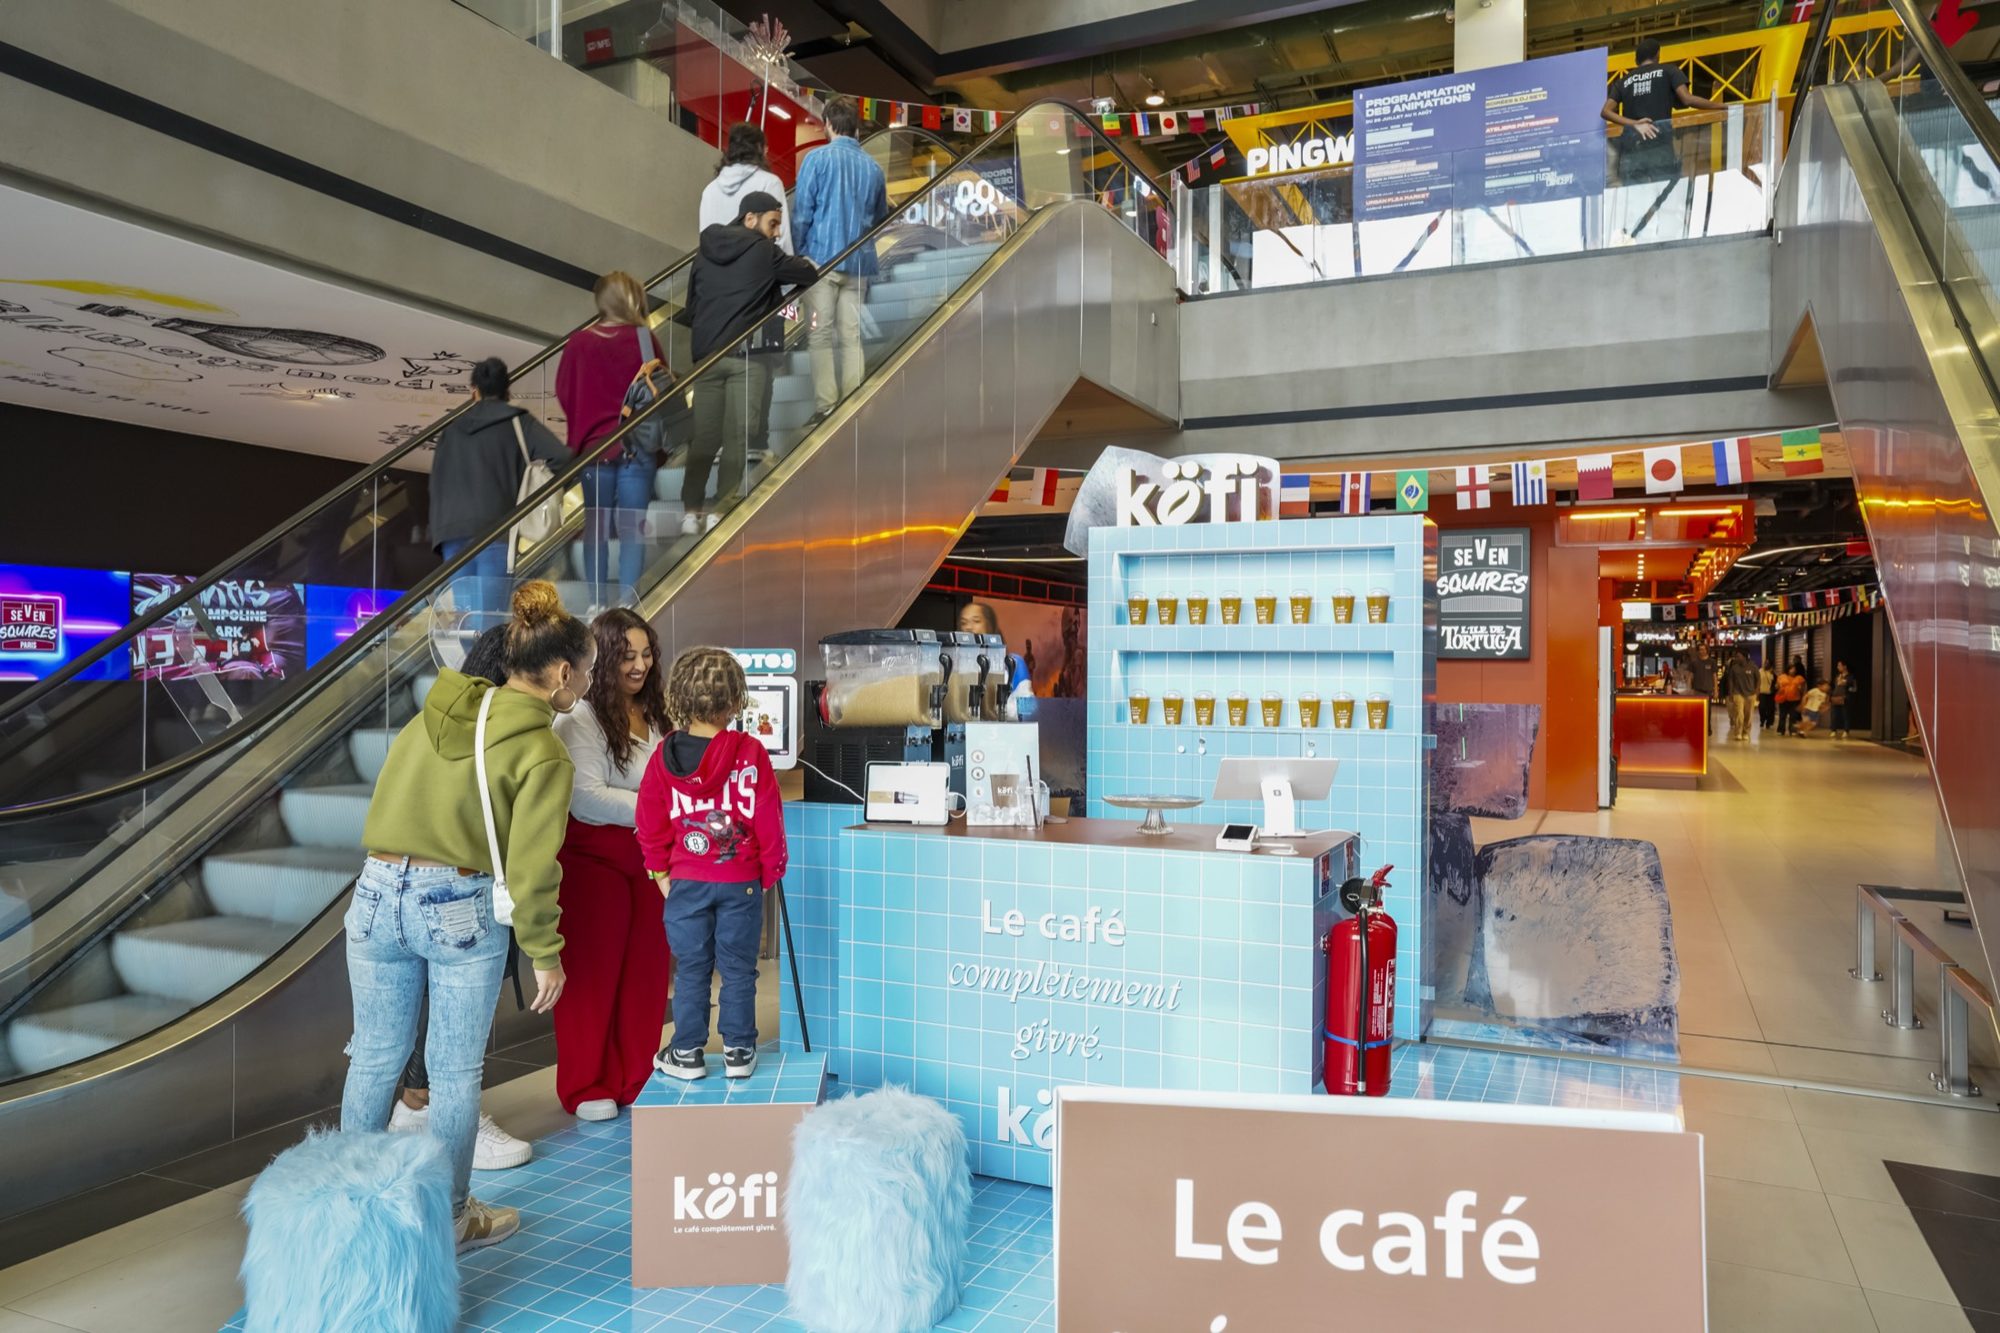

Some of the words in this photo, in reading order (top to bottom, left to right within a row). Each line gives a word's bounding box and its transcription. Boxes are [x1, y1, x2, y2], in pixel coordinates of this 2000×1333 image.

[1623, 69, 1664, 88] SECURITE
[1366, 82, 1475, 109] PROGRAMMATION
[1366, 106, 1391, 118] DES
[1392, 92, 1472, 114] ANIMATIONS
[1247, 134, 1355, 177] PINGW
[1116, 461, 1257, 527] köfi
[1454, 538, 1509, 566] SEVEN
[1436, 571, 1529, 595] SQUARES
[10, 604, 46, 622] SEVEN
[179, 607, 268, 622] TMPOLINE
[0, 625, 58, 640] SQUARES
[216, 625, 243, 638] ARK
[1441, 625, 1523, 656] TORTUGA
[1489, 625, 1506, 634] DE
[20, 641, 37, 649] PARIS
[738, 653, 794, 669] OTOS
[983, 899, 1026, 937] Le
[1039, 906, 1127, 946] café
[949, 960, 1184, 1011] complètement
[1011, 1018, 1104, 1061] givré.
[674, 1171, 778, 1220] köfi
[673, 1226, 683, 1234] Le
[684, 1225, 700, 1233] café
[701, 1224, 754, 1234] complètement
[755, 1223, 777, 1233] givré.
[1175, 1178, 1283, 1266] Le
[1319, 1190, 1541, 1285] café
